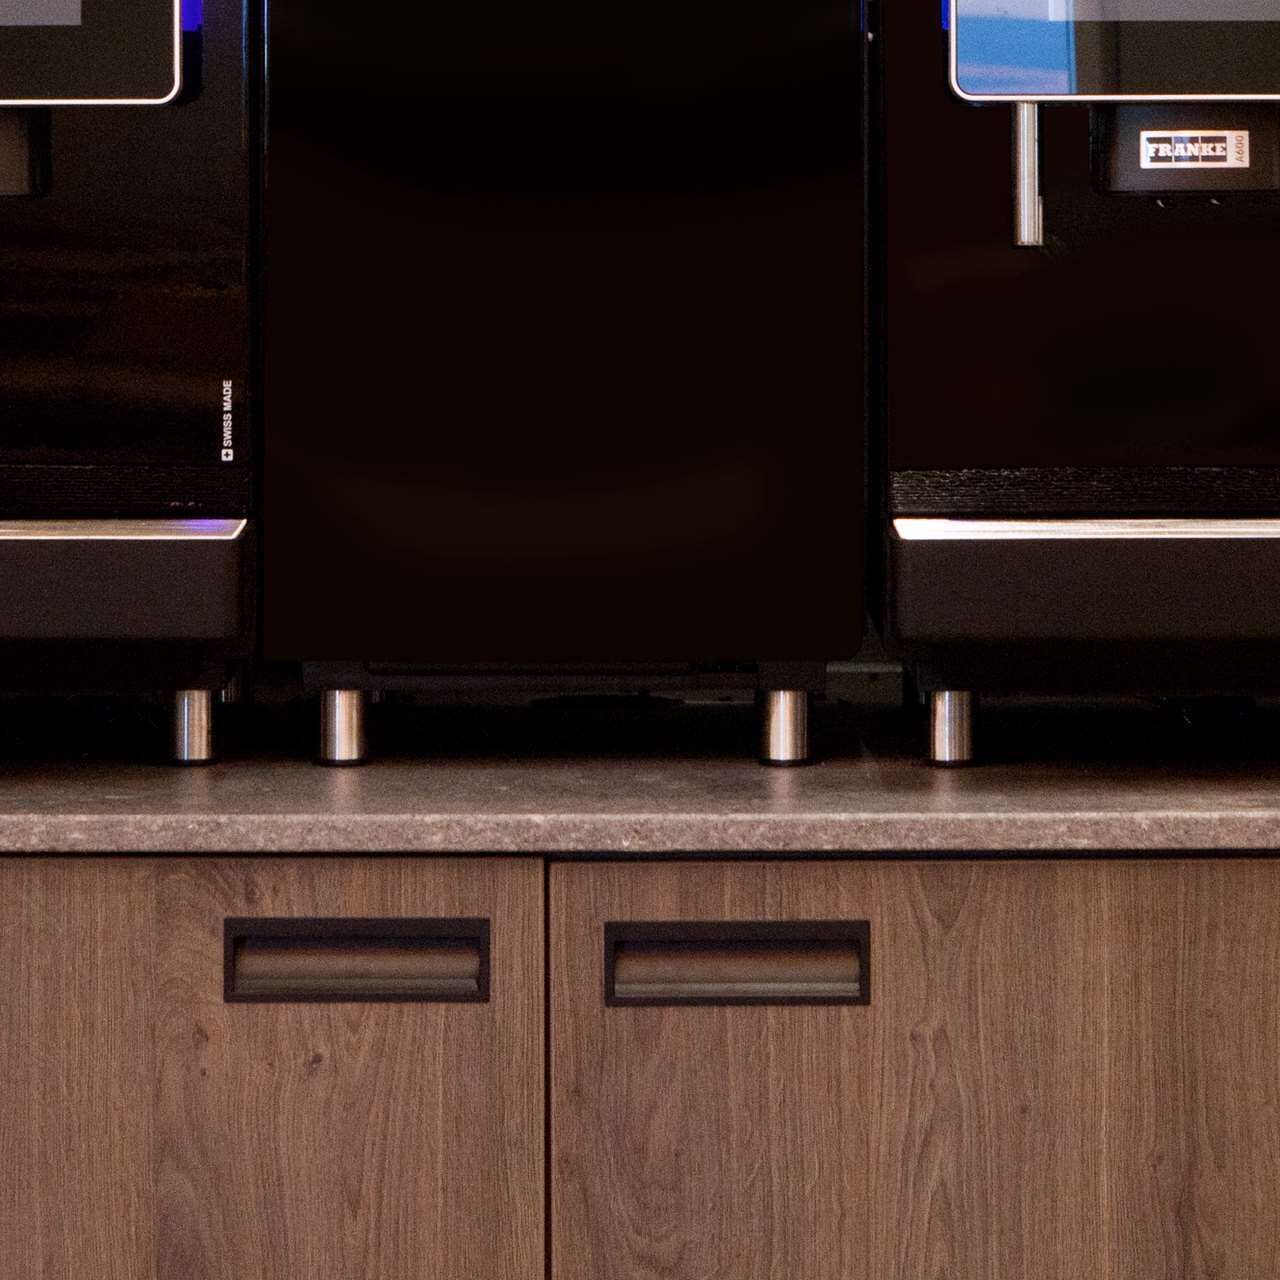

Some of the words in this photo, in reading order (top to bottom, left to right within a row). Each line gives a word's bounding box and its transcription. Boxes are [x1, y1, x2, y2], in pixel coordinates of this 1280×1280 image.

[1147, 141, 1227, 158] FRANKE
[1235, 135, 1244, 162] A600
[223, 380, 232, 411] MADE
[223, 413, 232, 447] SWISS
